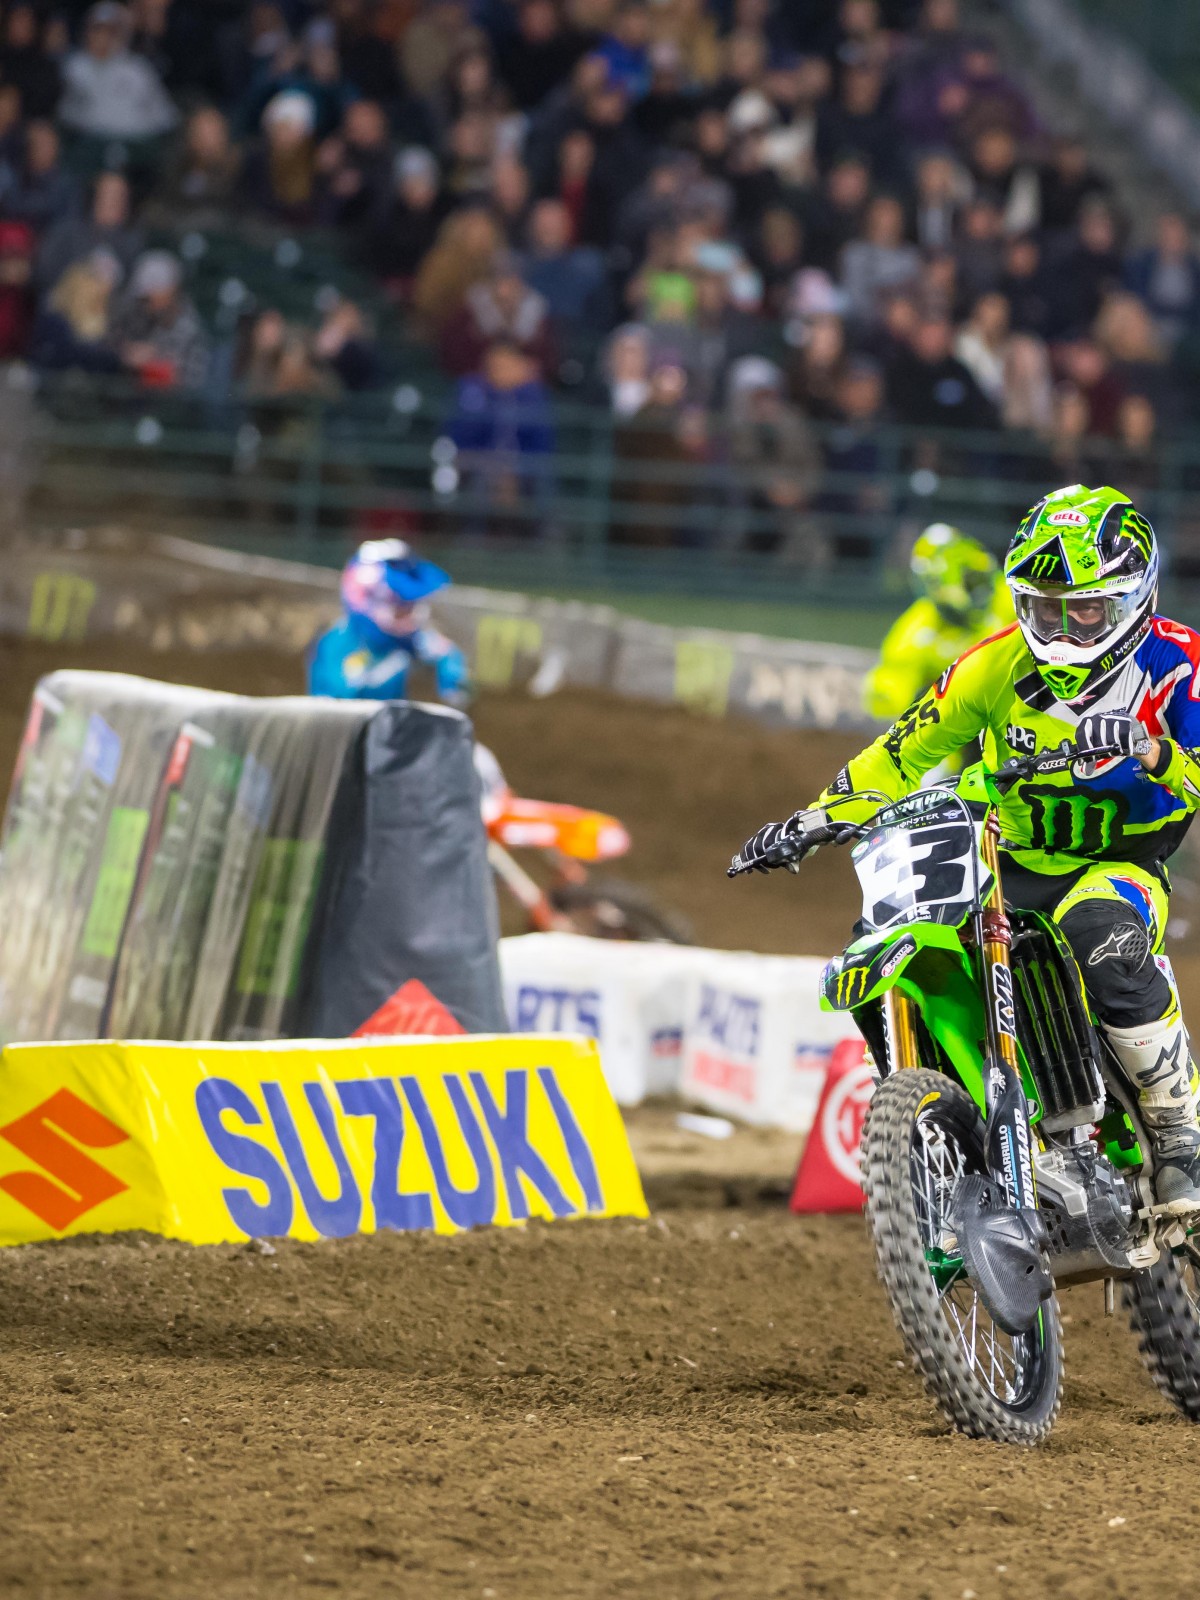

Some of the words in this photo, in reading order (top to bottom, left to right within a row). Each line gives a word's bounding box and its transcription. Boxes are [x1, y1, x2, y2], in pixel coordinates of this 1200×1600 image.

[1053, 513, 1082, 523] BELL
[195, 1067, 604, 1239] SUZUKI
[999, 1125, 1014, 1181] CARRILLO
[1014, 1108, 1036, 1210] DUNLOP
